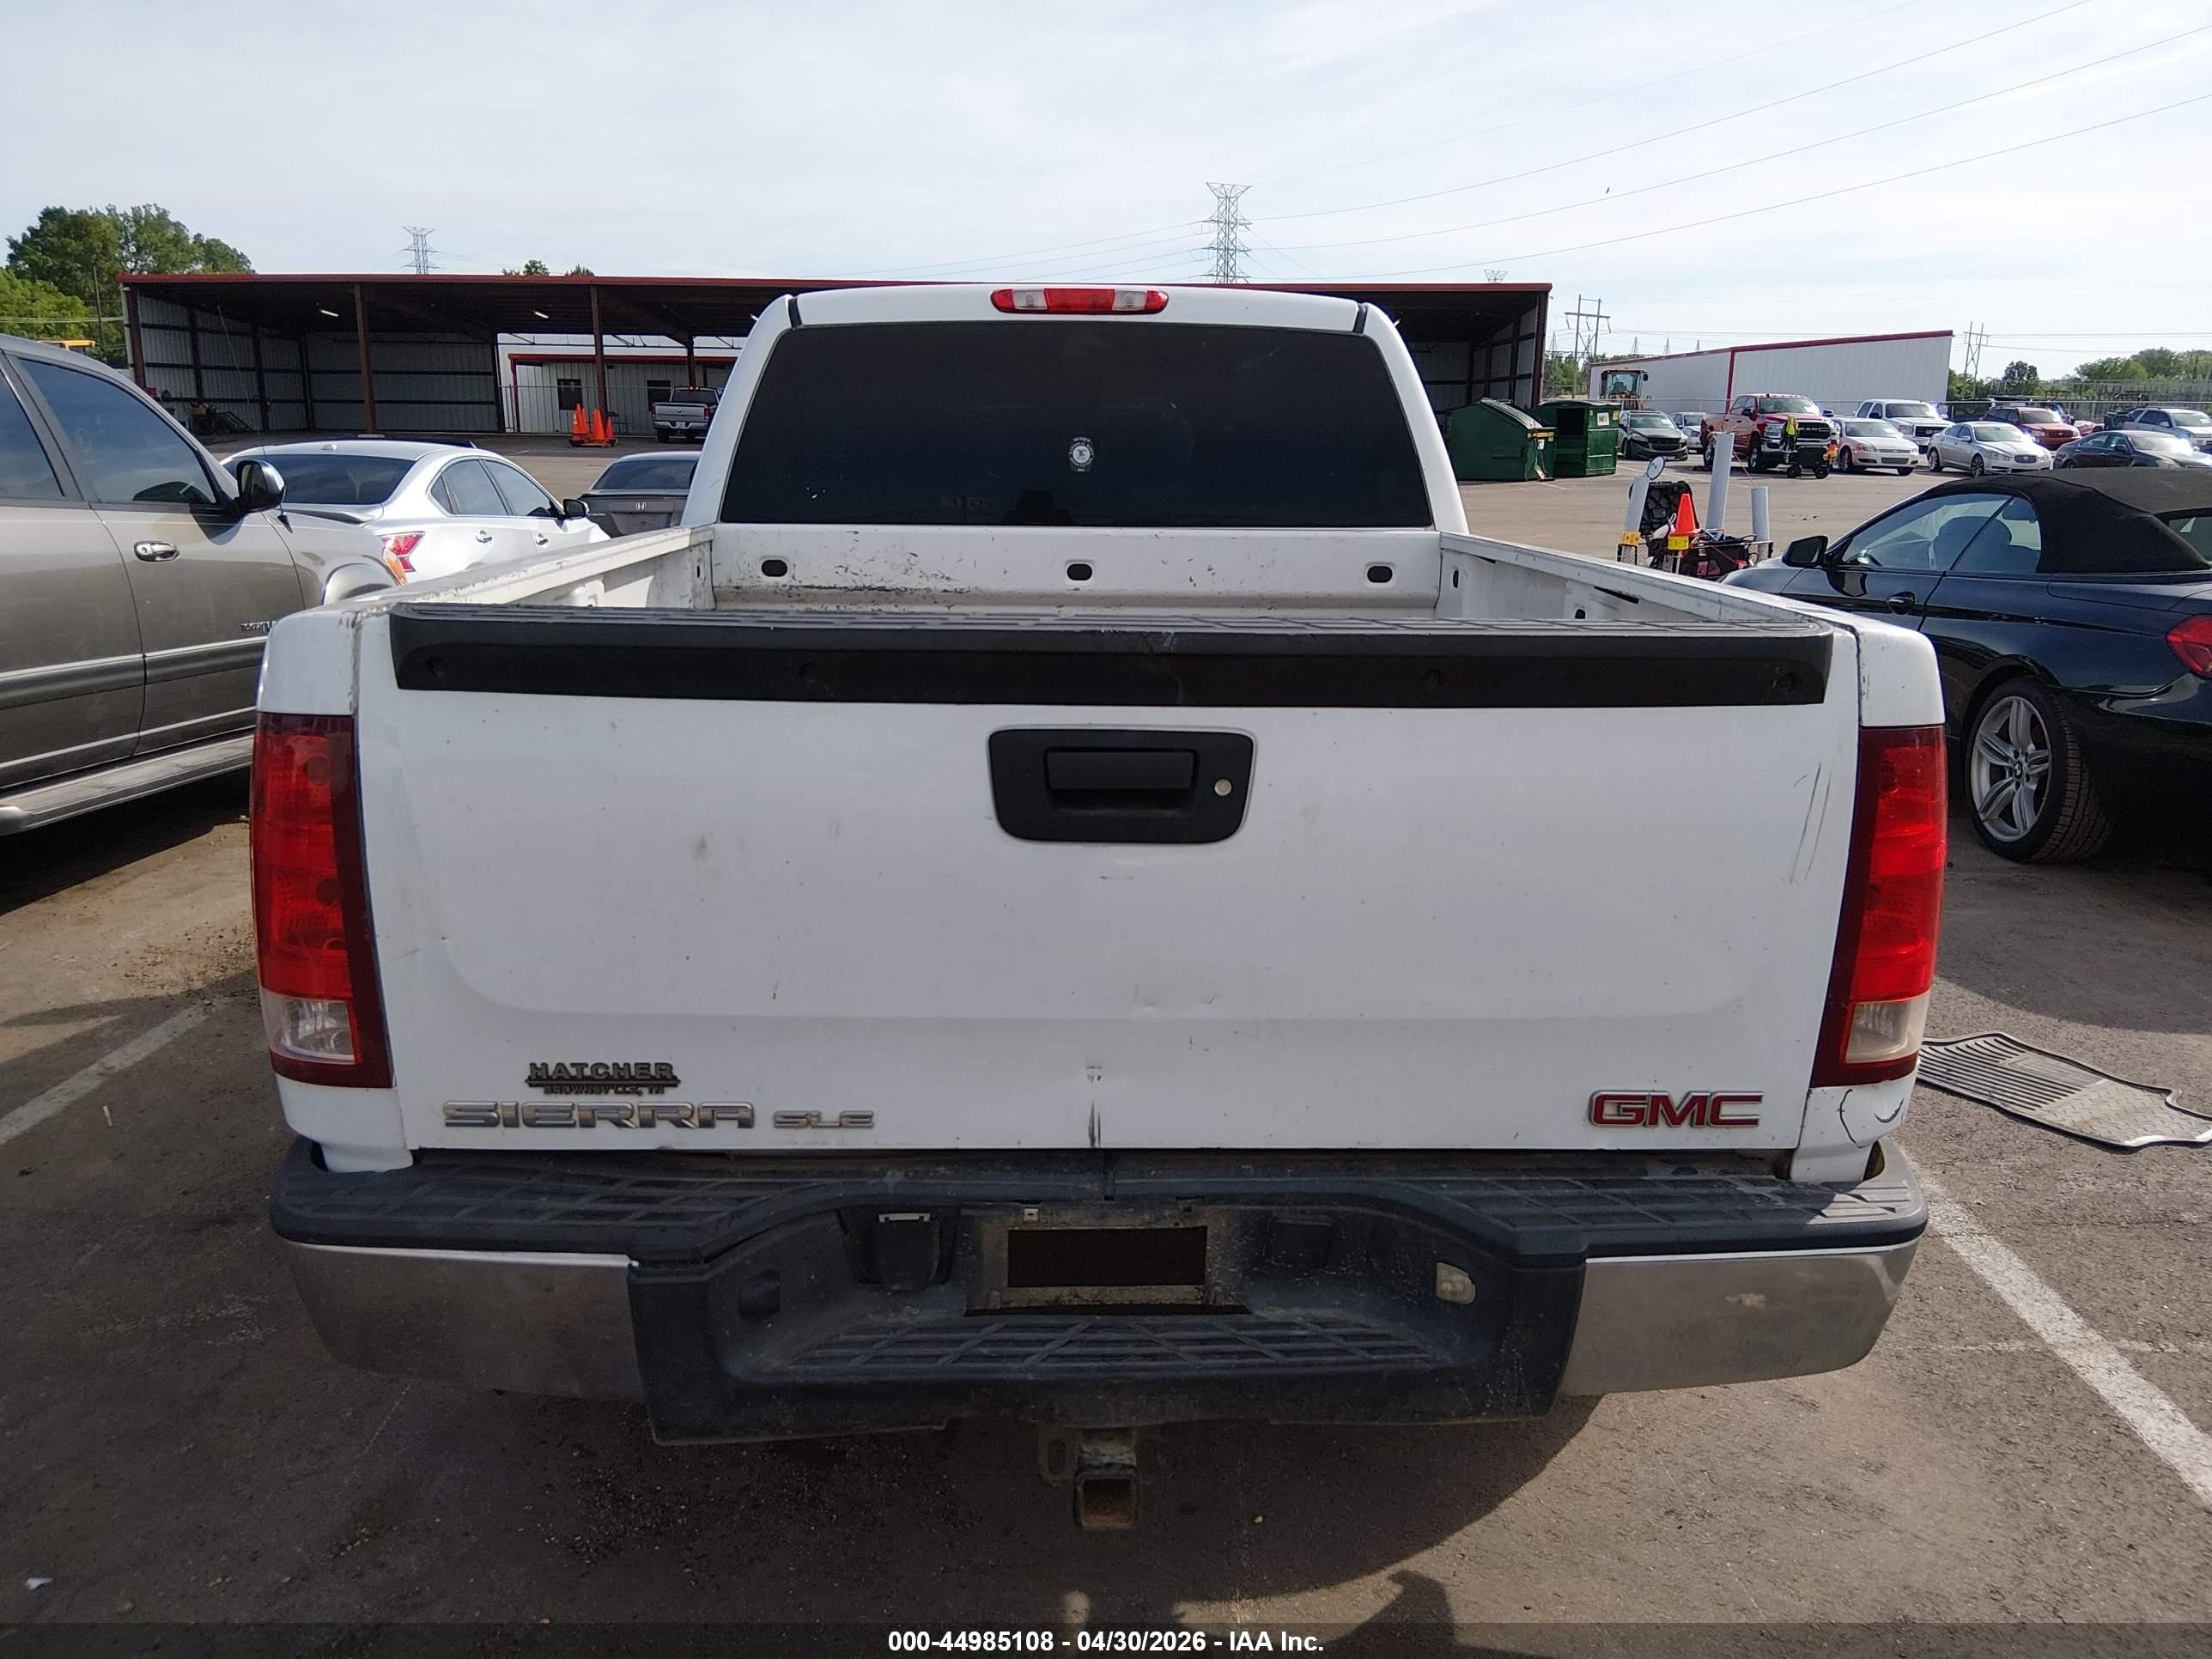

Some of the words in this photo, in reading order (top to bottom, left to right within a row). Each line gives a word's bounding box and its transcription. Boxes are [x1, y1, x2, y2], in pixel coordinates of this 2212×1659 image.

[529, 1062, 674, 1079] HATCHER
[442, 1101, 755, 1128] SIERRA
[774, 1110, 875, 1128] SLE
[1589, 1090, 1765, 1127] GMC
